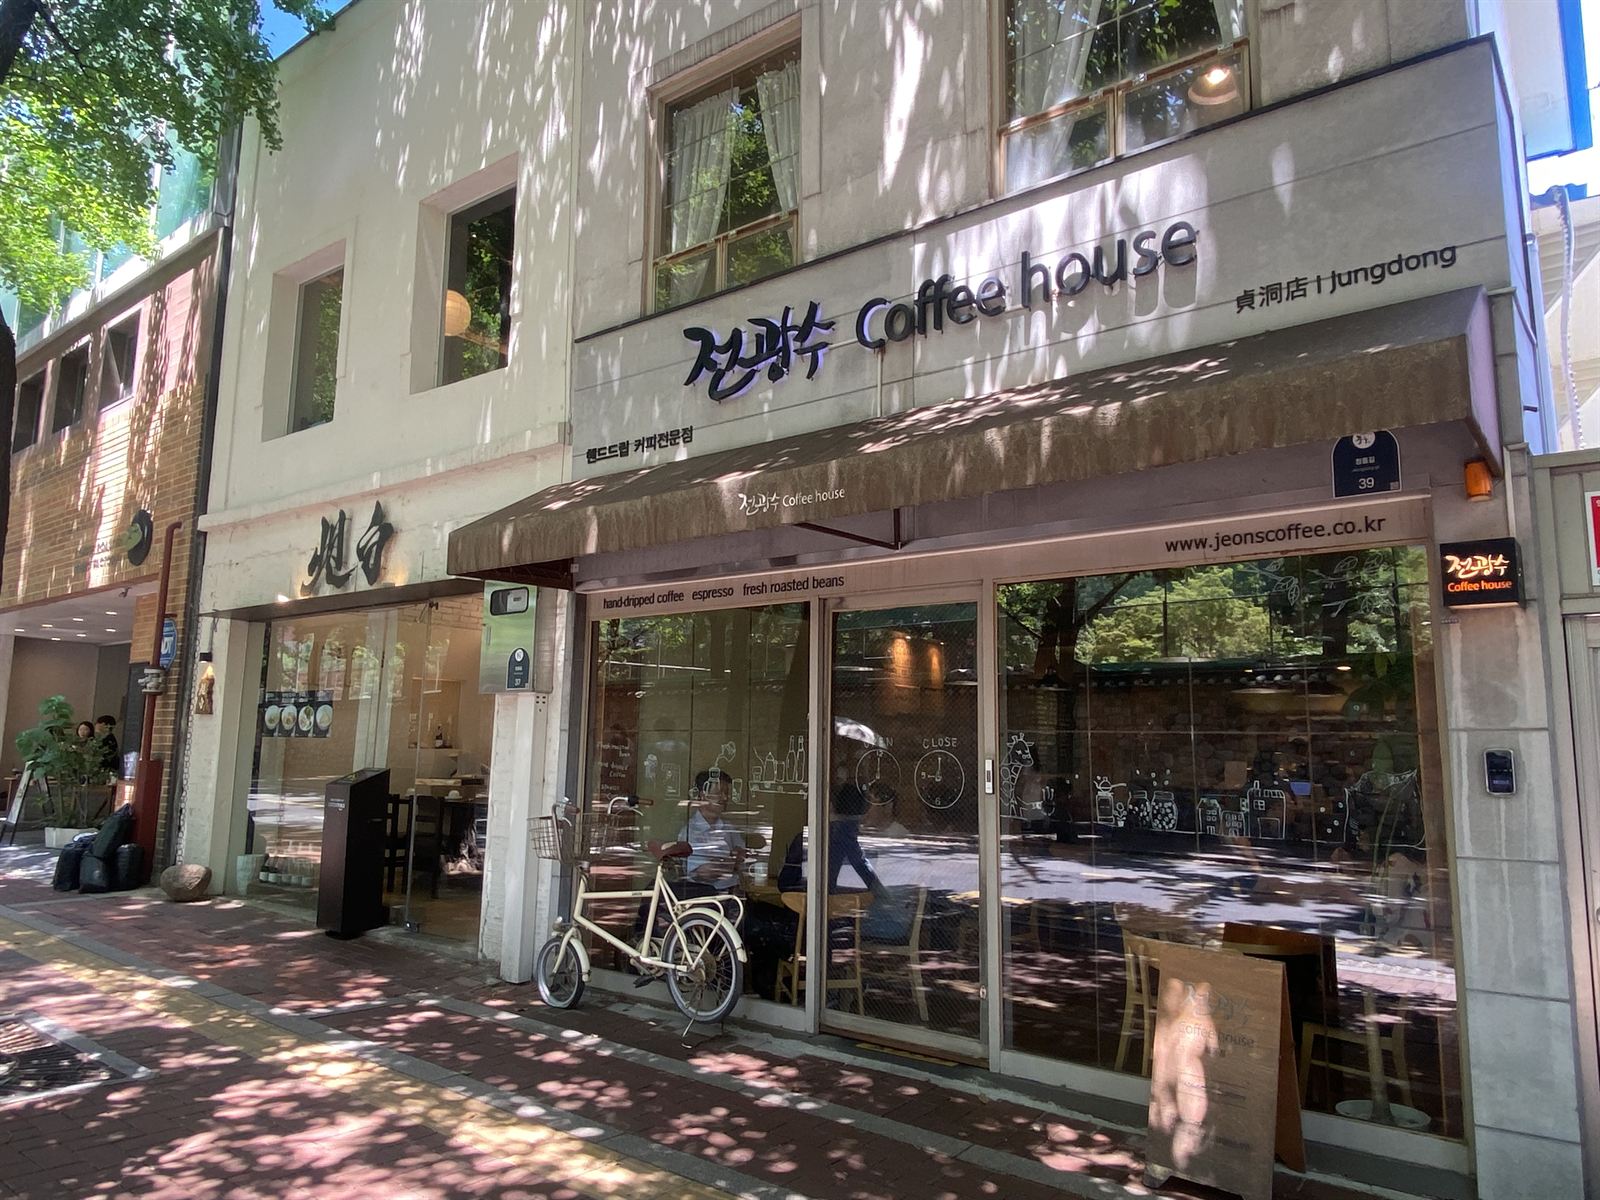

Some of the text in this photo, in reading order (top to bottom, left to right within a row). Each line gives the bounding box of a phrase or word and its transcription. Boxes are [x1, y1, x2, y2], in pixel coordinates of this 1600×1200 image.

[1236, 277, 1308, 314] 貞洞店
[683, 220, 1199, 402] 전광수 Coffee house
[633, 425, 693, 453] 커피전문점
[1358, 477, 1375, 490] 39
[738, 488, 845, 516] 전광수 Coffee house
[1165, 516, 1386, 552] www.jeonscoffee.co.kr
[1444, 554, 1510, 579] 전광수
[603, 575, 845, 609] hand-dripped coffee espresso fresh roasted beans
[1447, 580, 1513, 593] Coffee house
[922, 737, 958, 749] CLOSE
